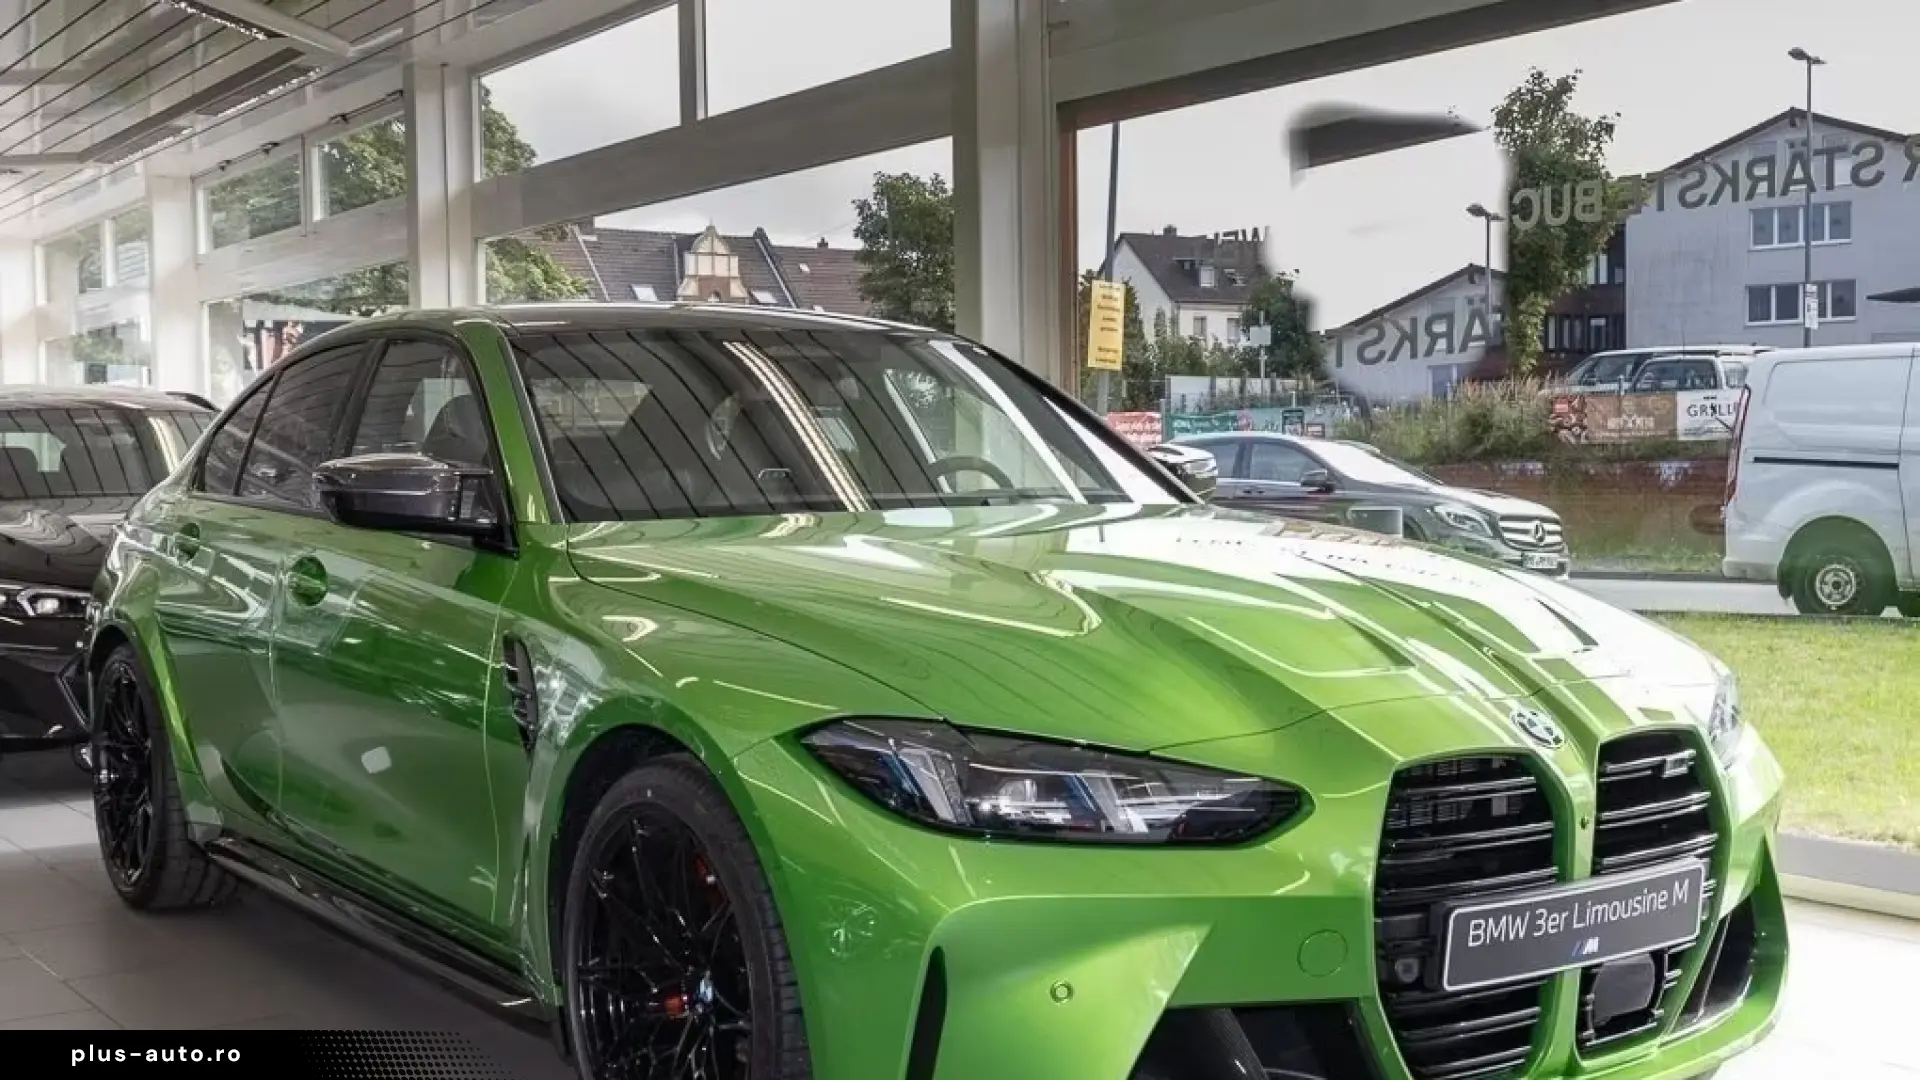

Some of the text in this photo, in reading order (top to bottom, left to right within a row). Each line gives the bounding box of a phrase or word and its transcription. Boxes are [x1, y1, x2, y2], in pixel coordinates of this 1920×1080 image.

[1467, 877, 1691, 947] BMW 3er Limousine M
